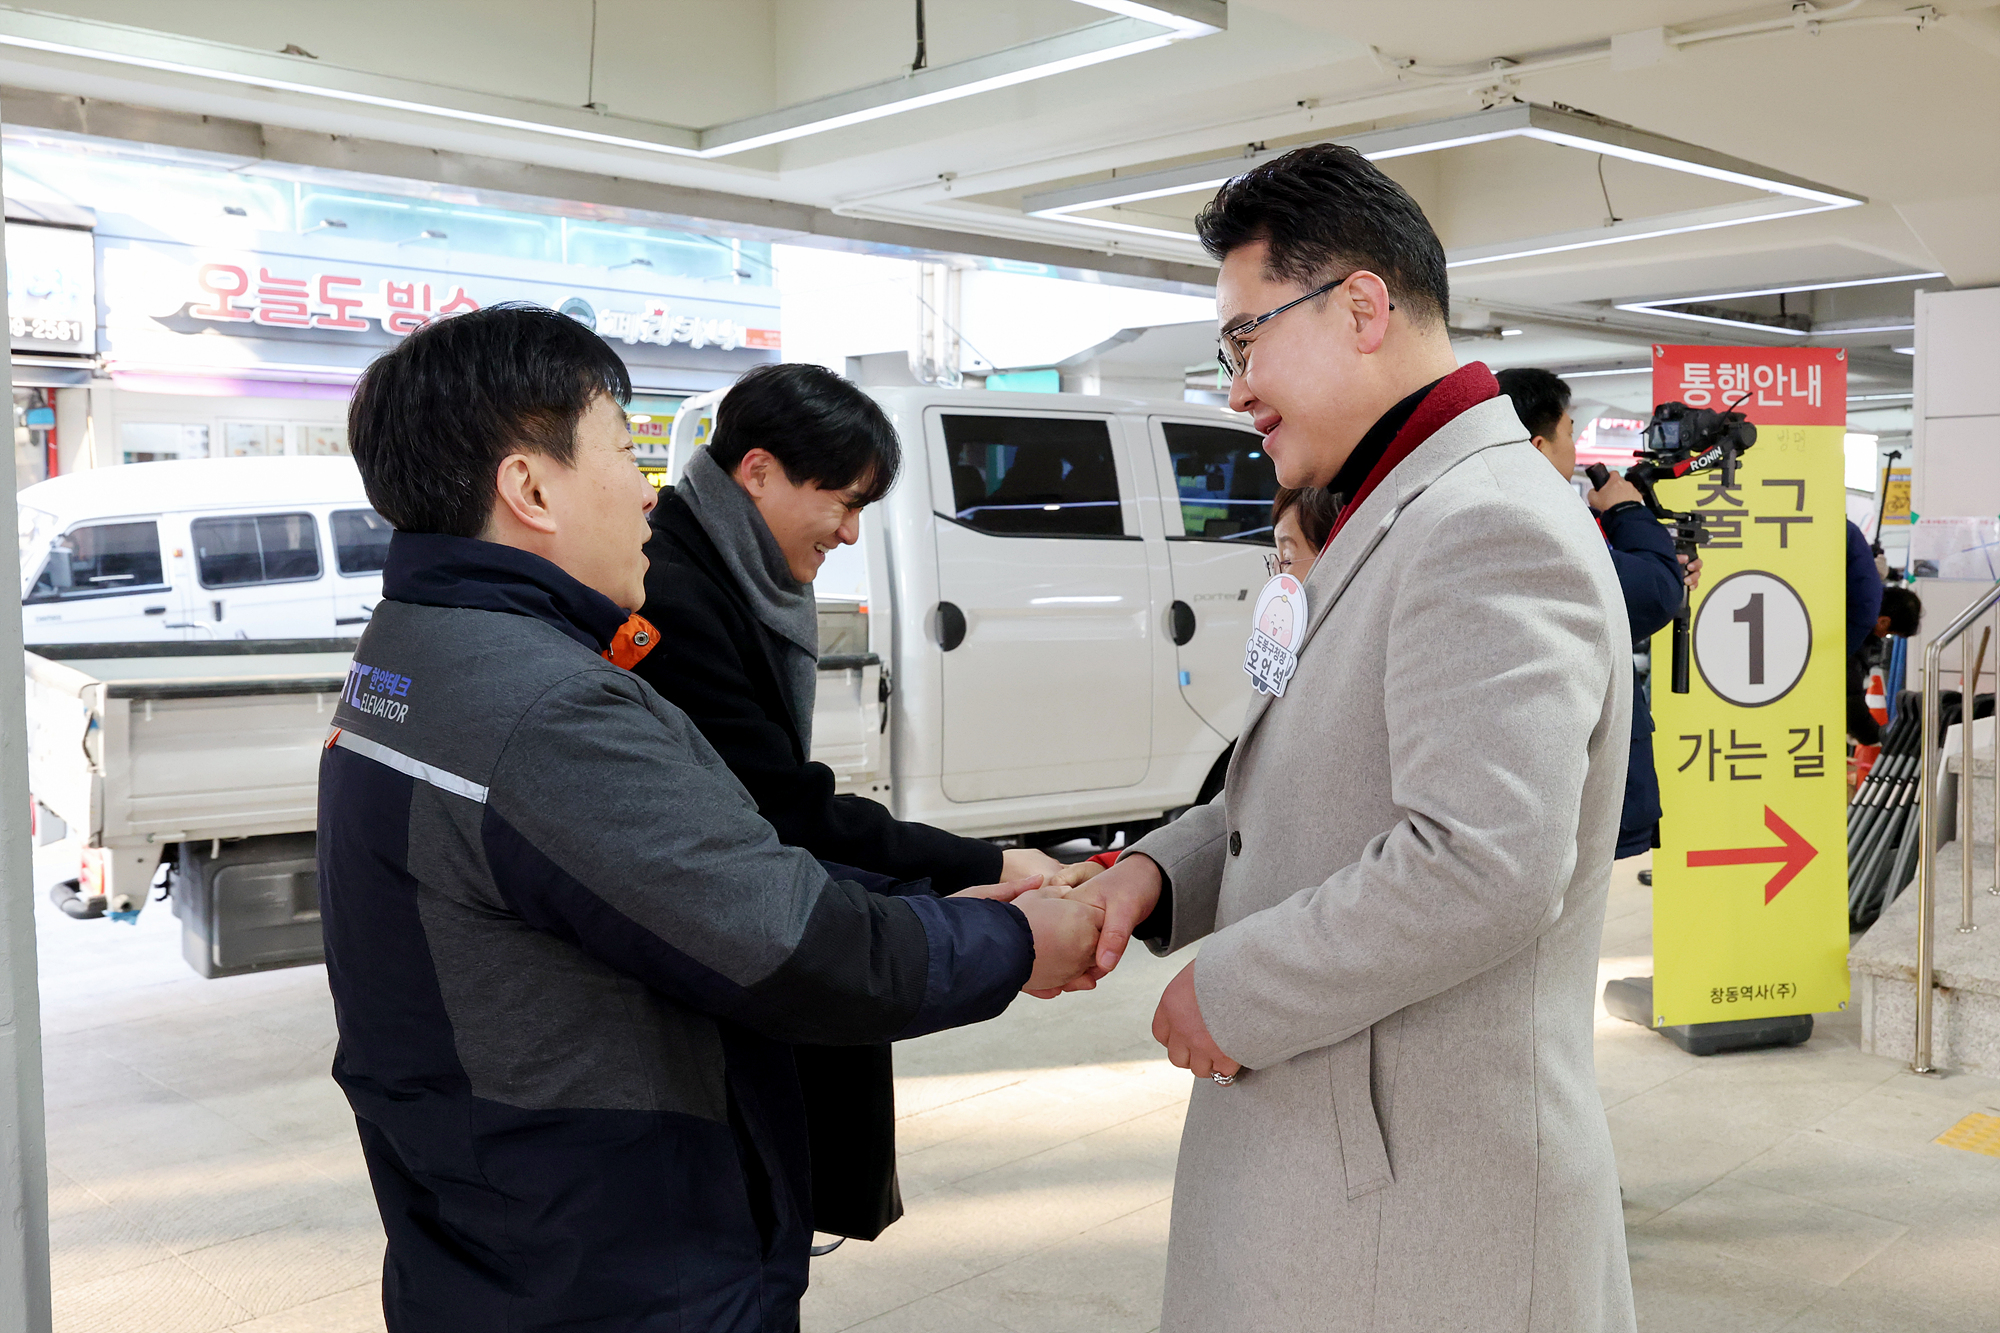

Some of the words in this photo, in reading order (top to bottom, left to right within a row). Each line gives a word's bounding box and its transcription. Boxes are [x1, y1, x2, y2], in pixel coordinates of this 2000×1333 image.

[194, 262, 368, 329] 오늘도
[10, 317, 81, 341] 9-2581
[1679, 362, 1822, 407] 통행안내
[1690, 445, 1722, 471] RONIN
[1691, 474, 1814, 549] 출구
[1256, 635, 1287, 665] 도봉구청장
[1733, 592, 1764, 685] 1
[369, 667, 412, 697] 한양테크
[360, 693, 409, 724] ELEVATOR
[1677, 728, 1768, 782] 가는
[1787, 724, 1825, 778] 길
[1710, 982, 1798, 1004] 창동역사(주)
